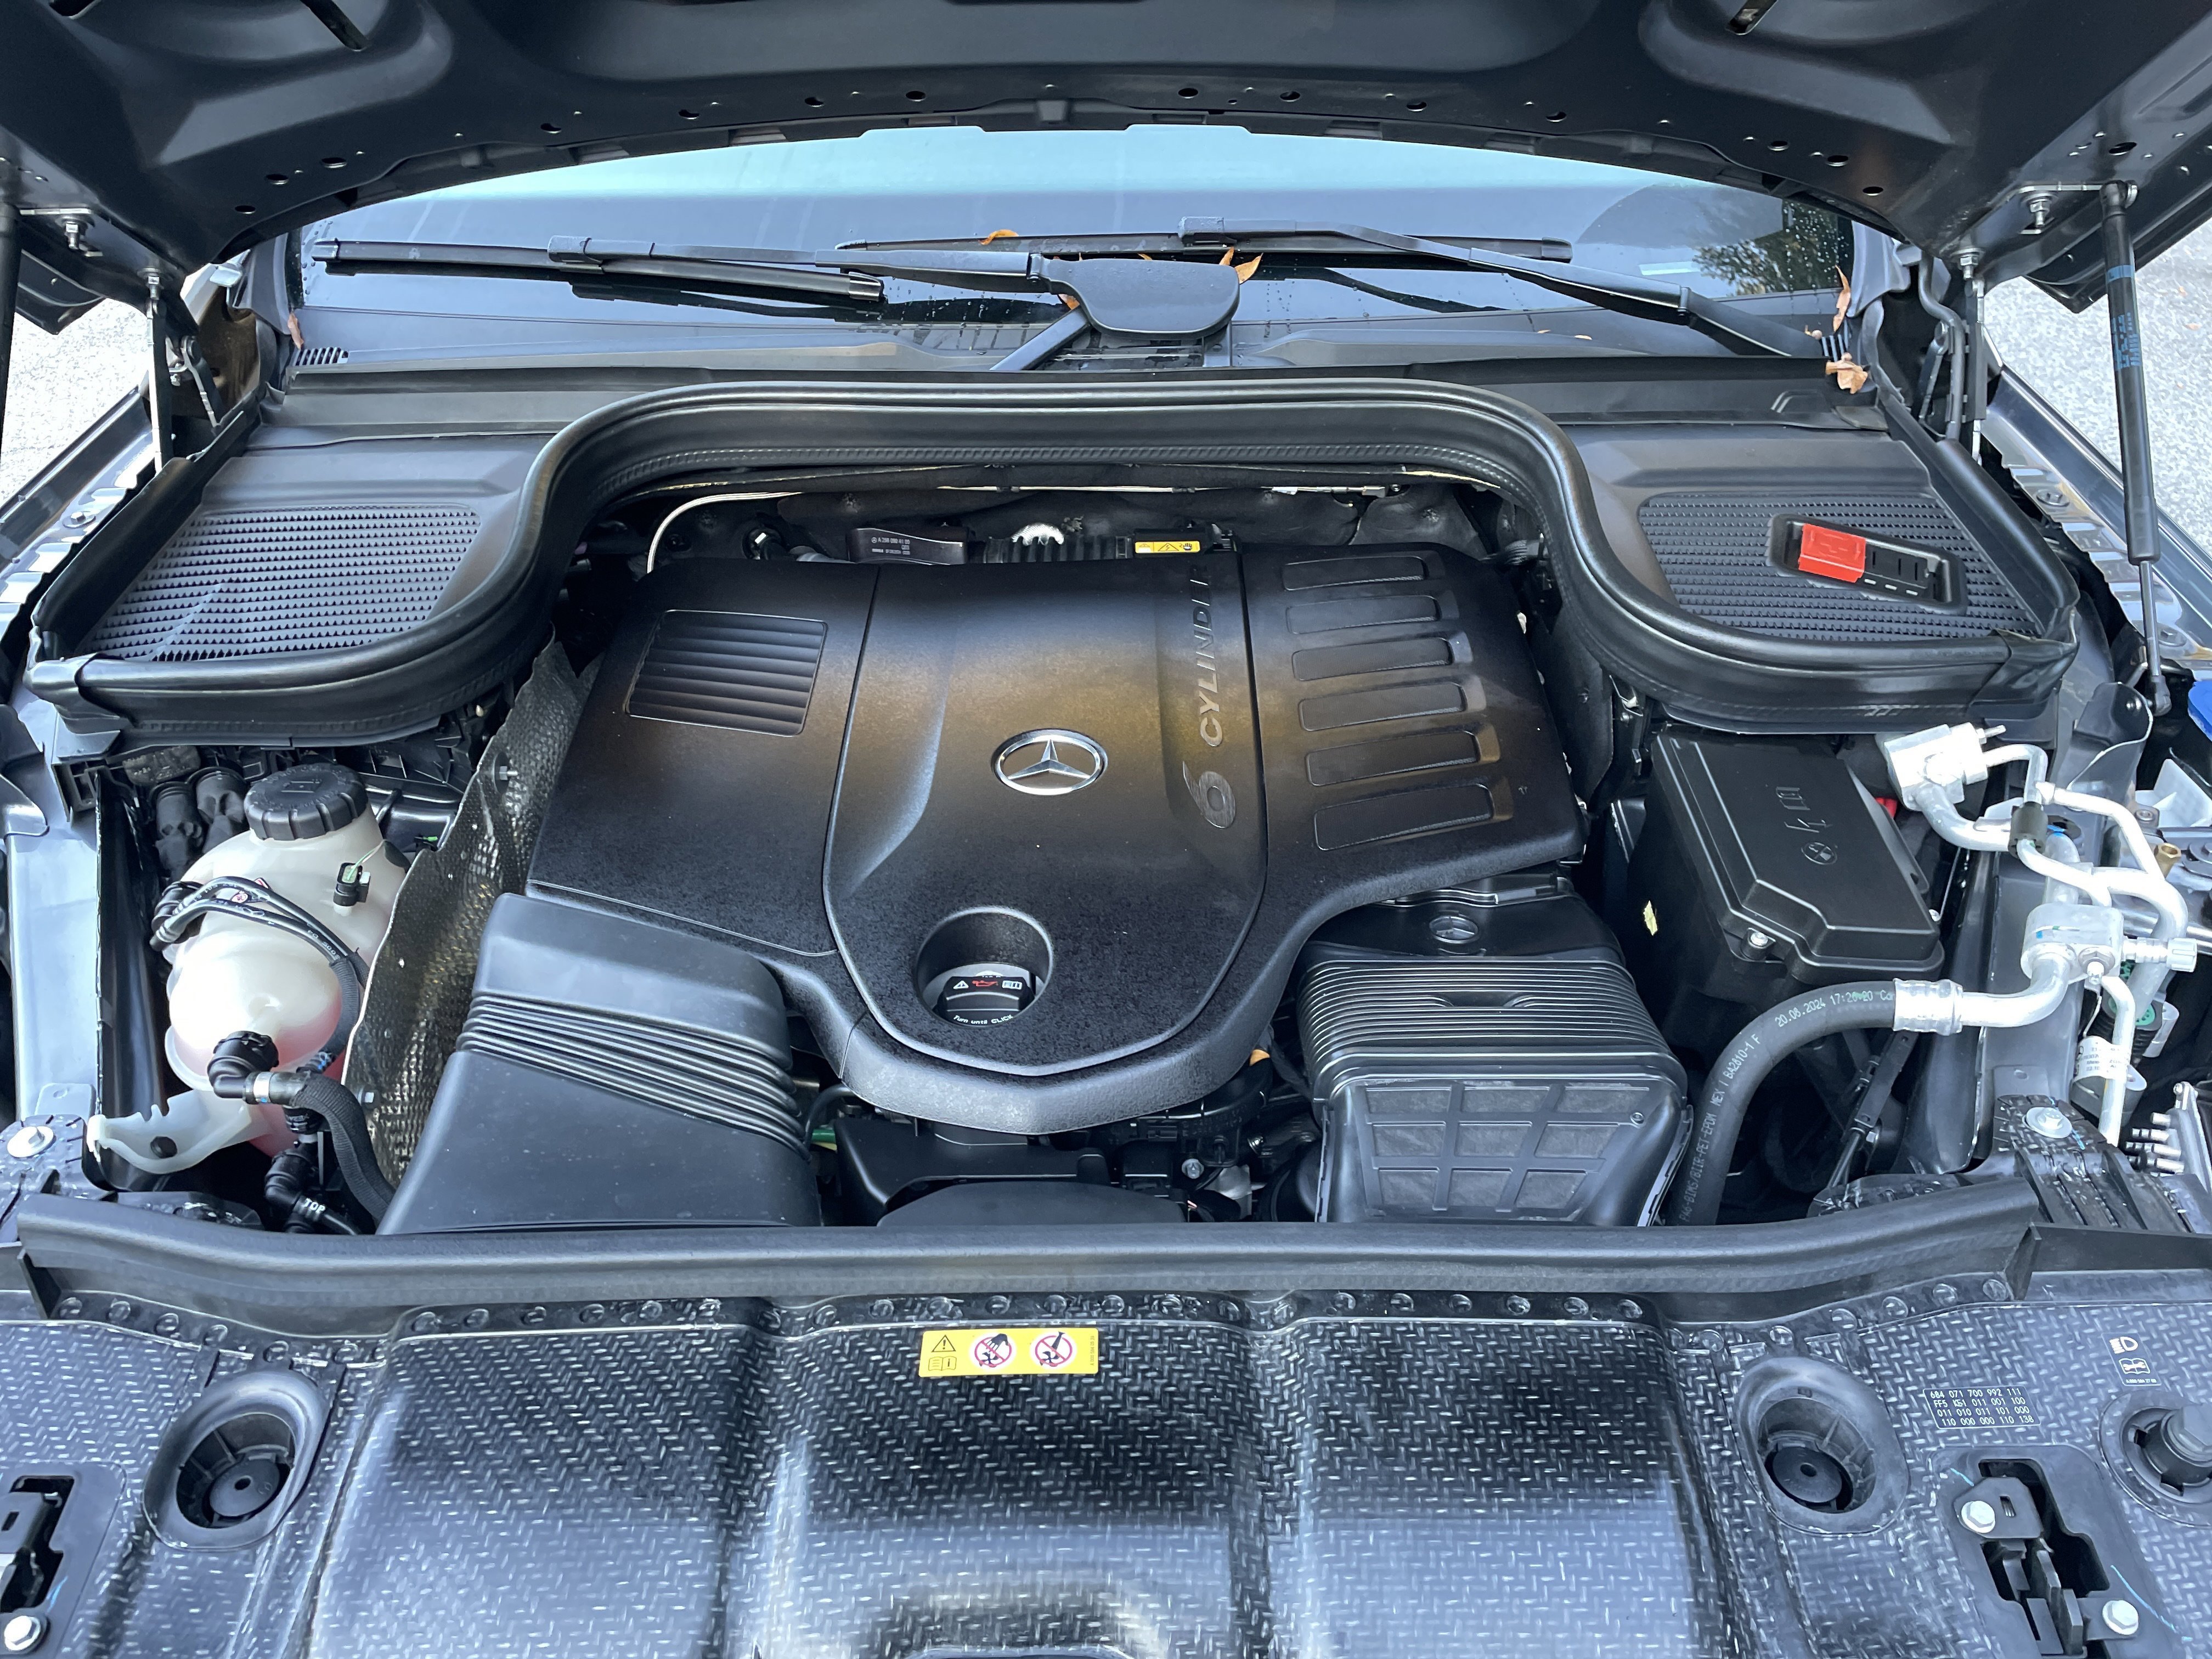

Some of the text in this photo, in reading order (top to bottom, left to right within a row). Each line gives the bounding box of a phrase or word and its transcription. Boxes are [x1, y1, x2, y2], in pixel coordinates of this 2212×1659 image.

[1775, 997, 1826, 1027] 20.08.2024
[953, 1015, 968, 1023] Turn
[991, 1014, 1013, 1024] CLICK
[302, 1198, 326, 1214] TOP
[1949, 1390, 1963, 1398] 071
[1967, 1389, 1983, 1397] 700
[1933, 1400, 1948, 1408] FF5
[1937, 1409, 1953, 1417] 011
[1956, 1408, 1972, 1417] 010
[1995, 1407, 2010, 1415] 101
[1942, 1415, 2034, 1426] 110 000 000 110 138
